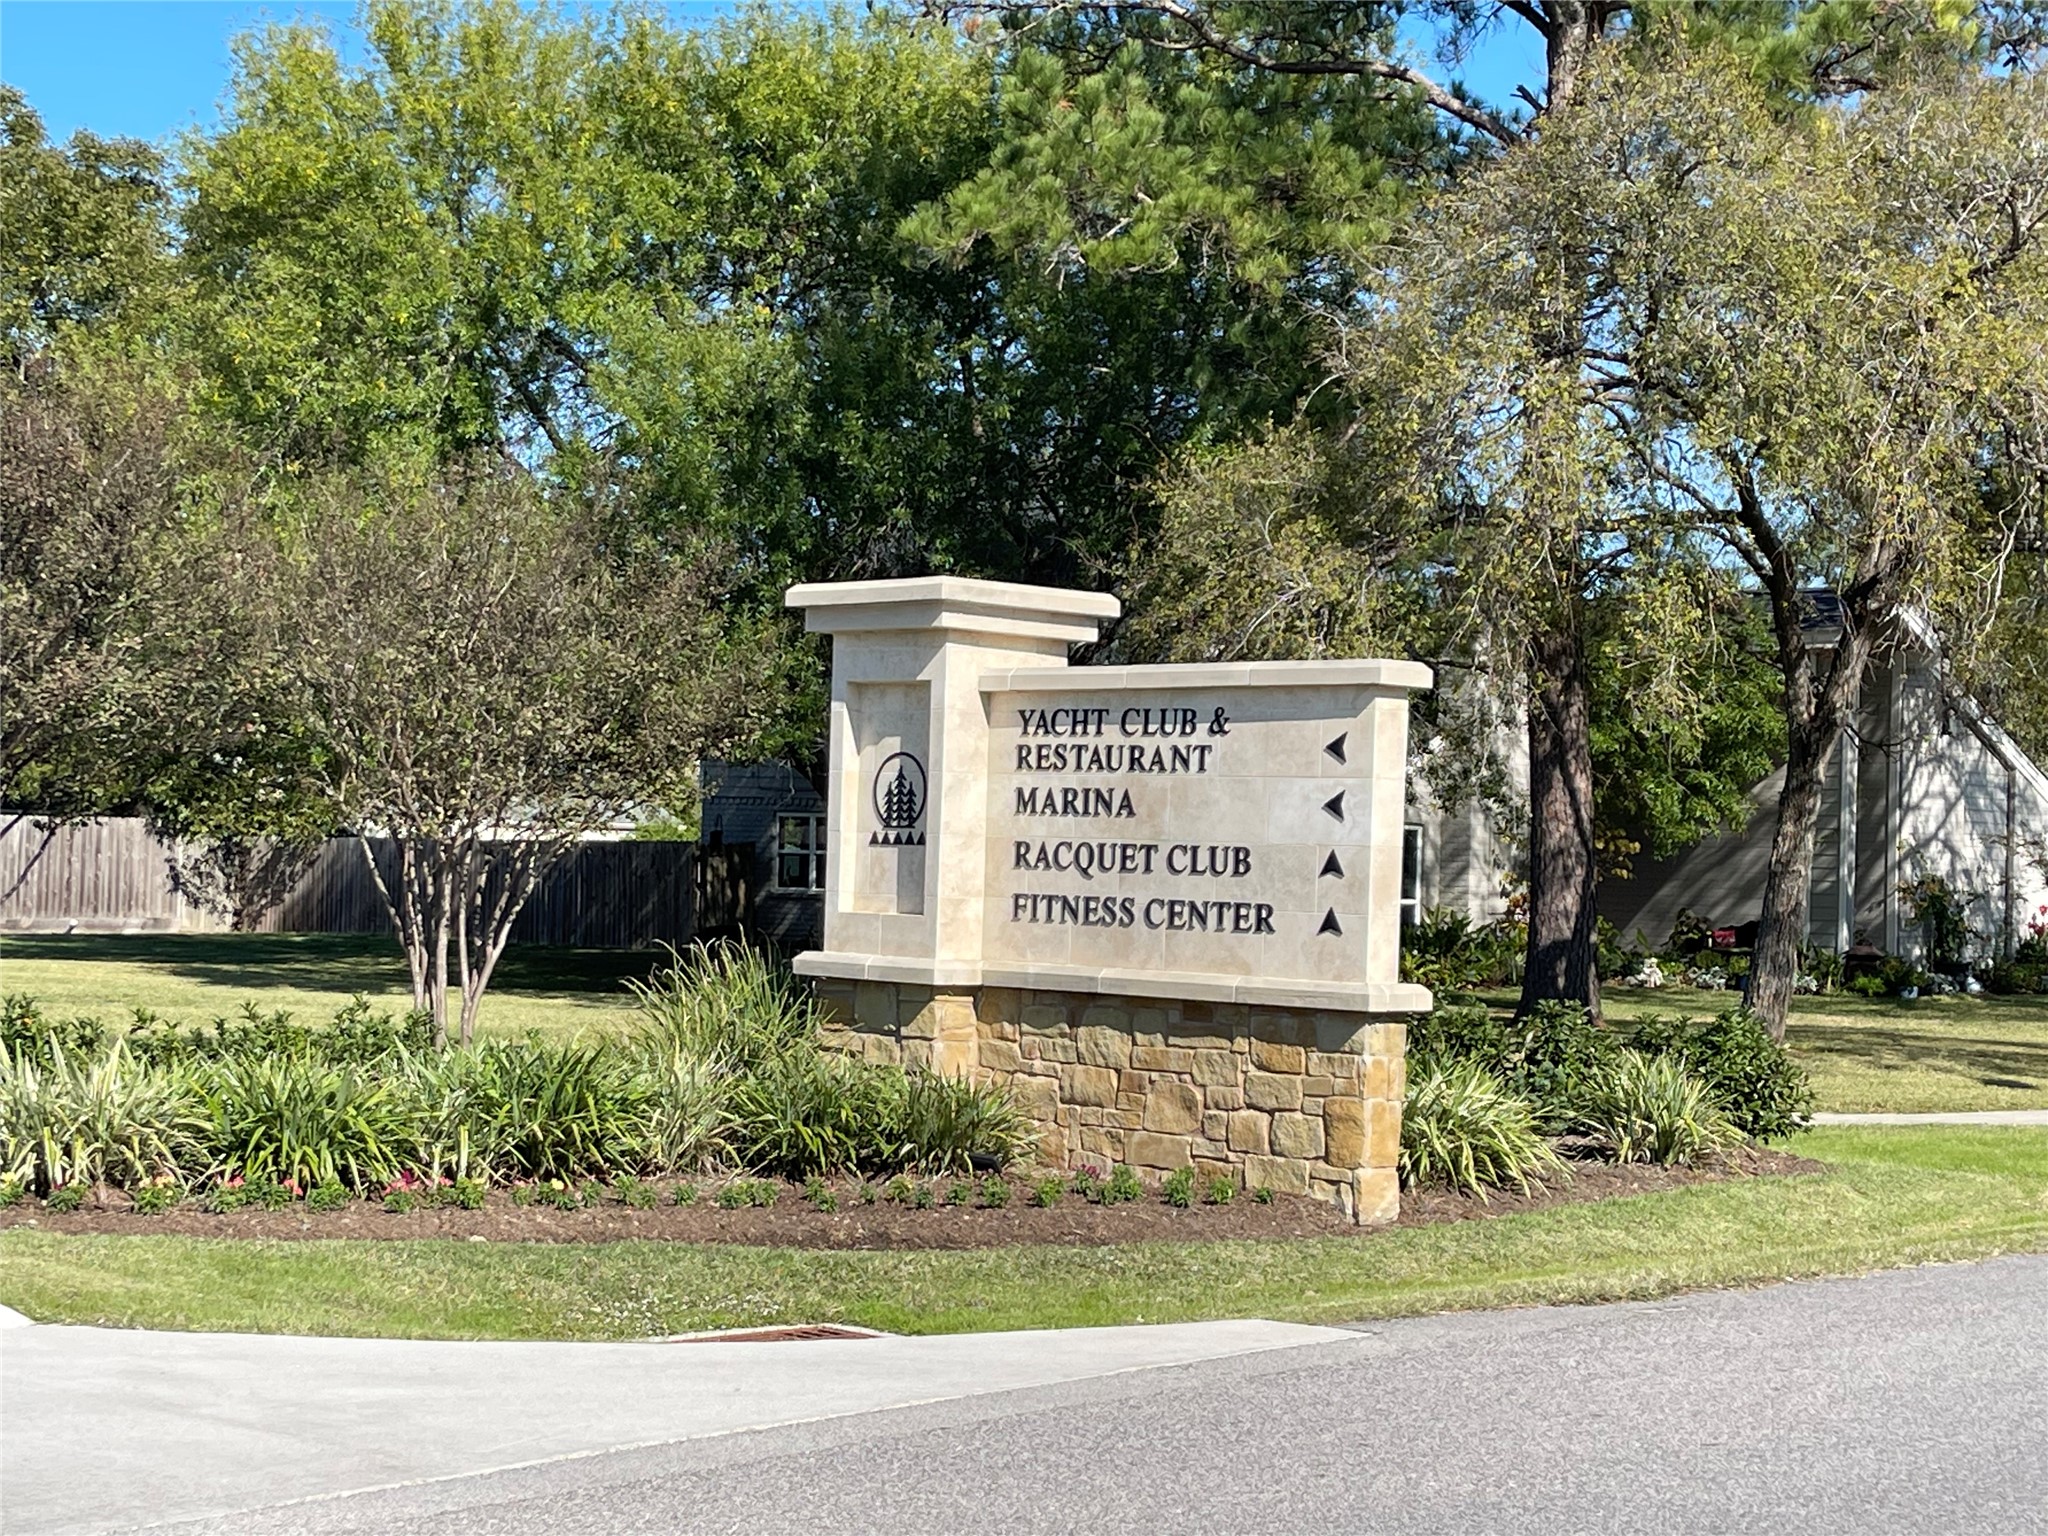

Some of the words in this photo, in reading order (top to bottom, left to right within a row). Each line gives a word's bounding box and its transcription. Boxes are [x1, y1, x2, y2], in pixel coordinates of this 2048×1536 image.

[1017, 708, 1109, 737] YACHT
[1120, 707, 1198, 736] CLUB
[1208, 706, 1231, 735] &
[1015, 744, 1213, 774] RESTAURANT
[1014, 787, 1137, 818] MARINA
[1013, 841, 1159, 880] RACQUET
[1166, 844, 1252, 878] CLUB
[1011, 893, 1135, 927] FITNESS
[1143, 898, 1276, 936] CENTER
